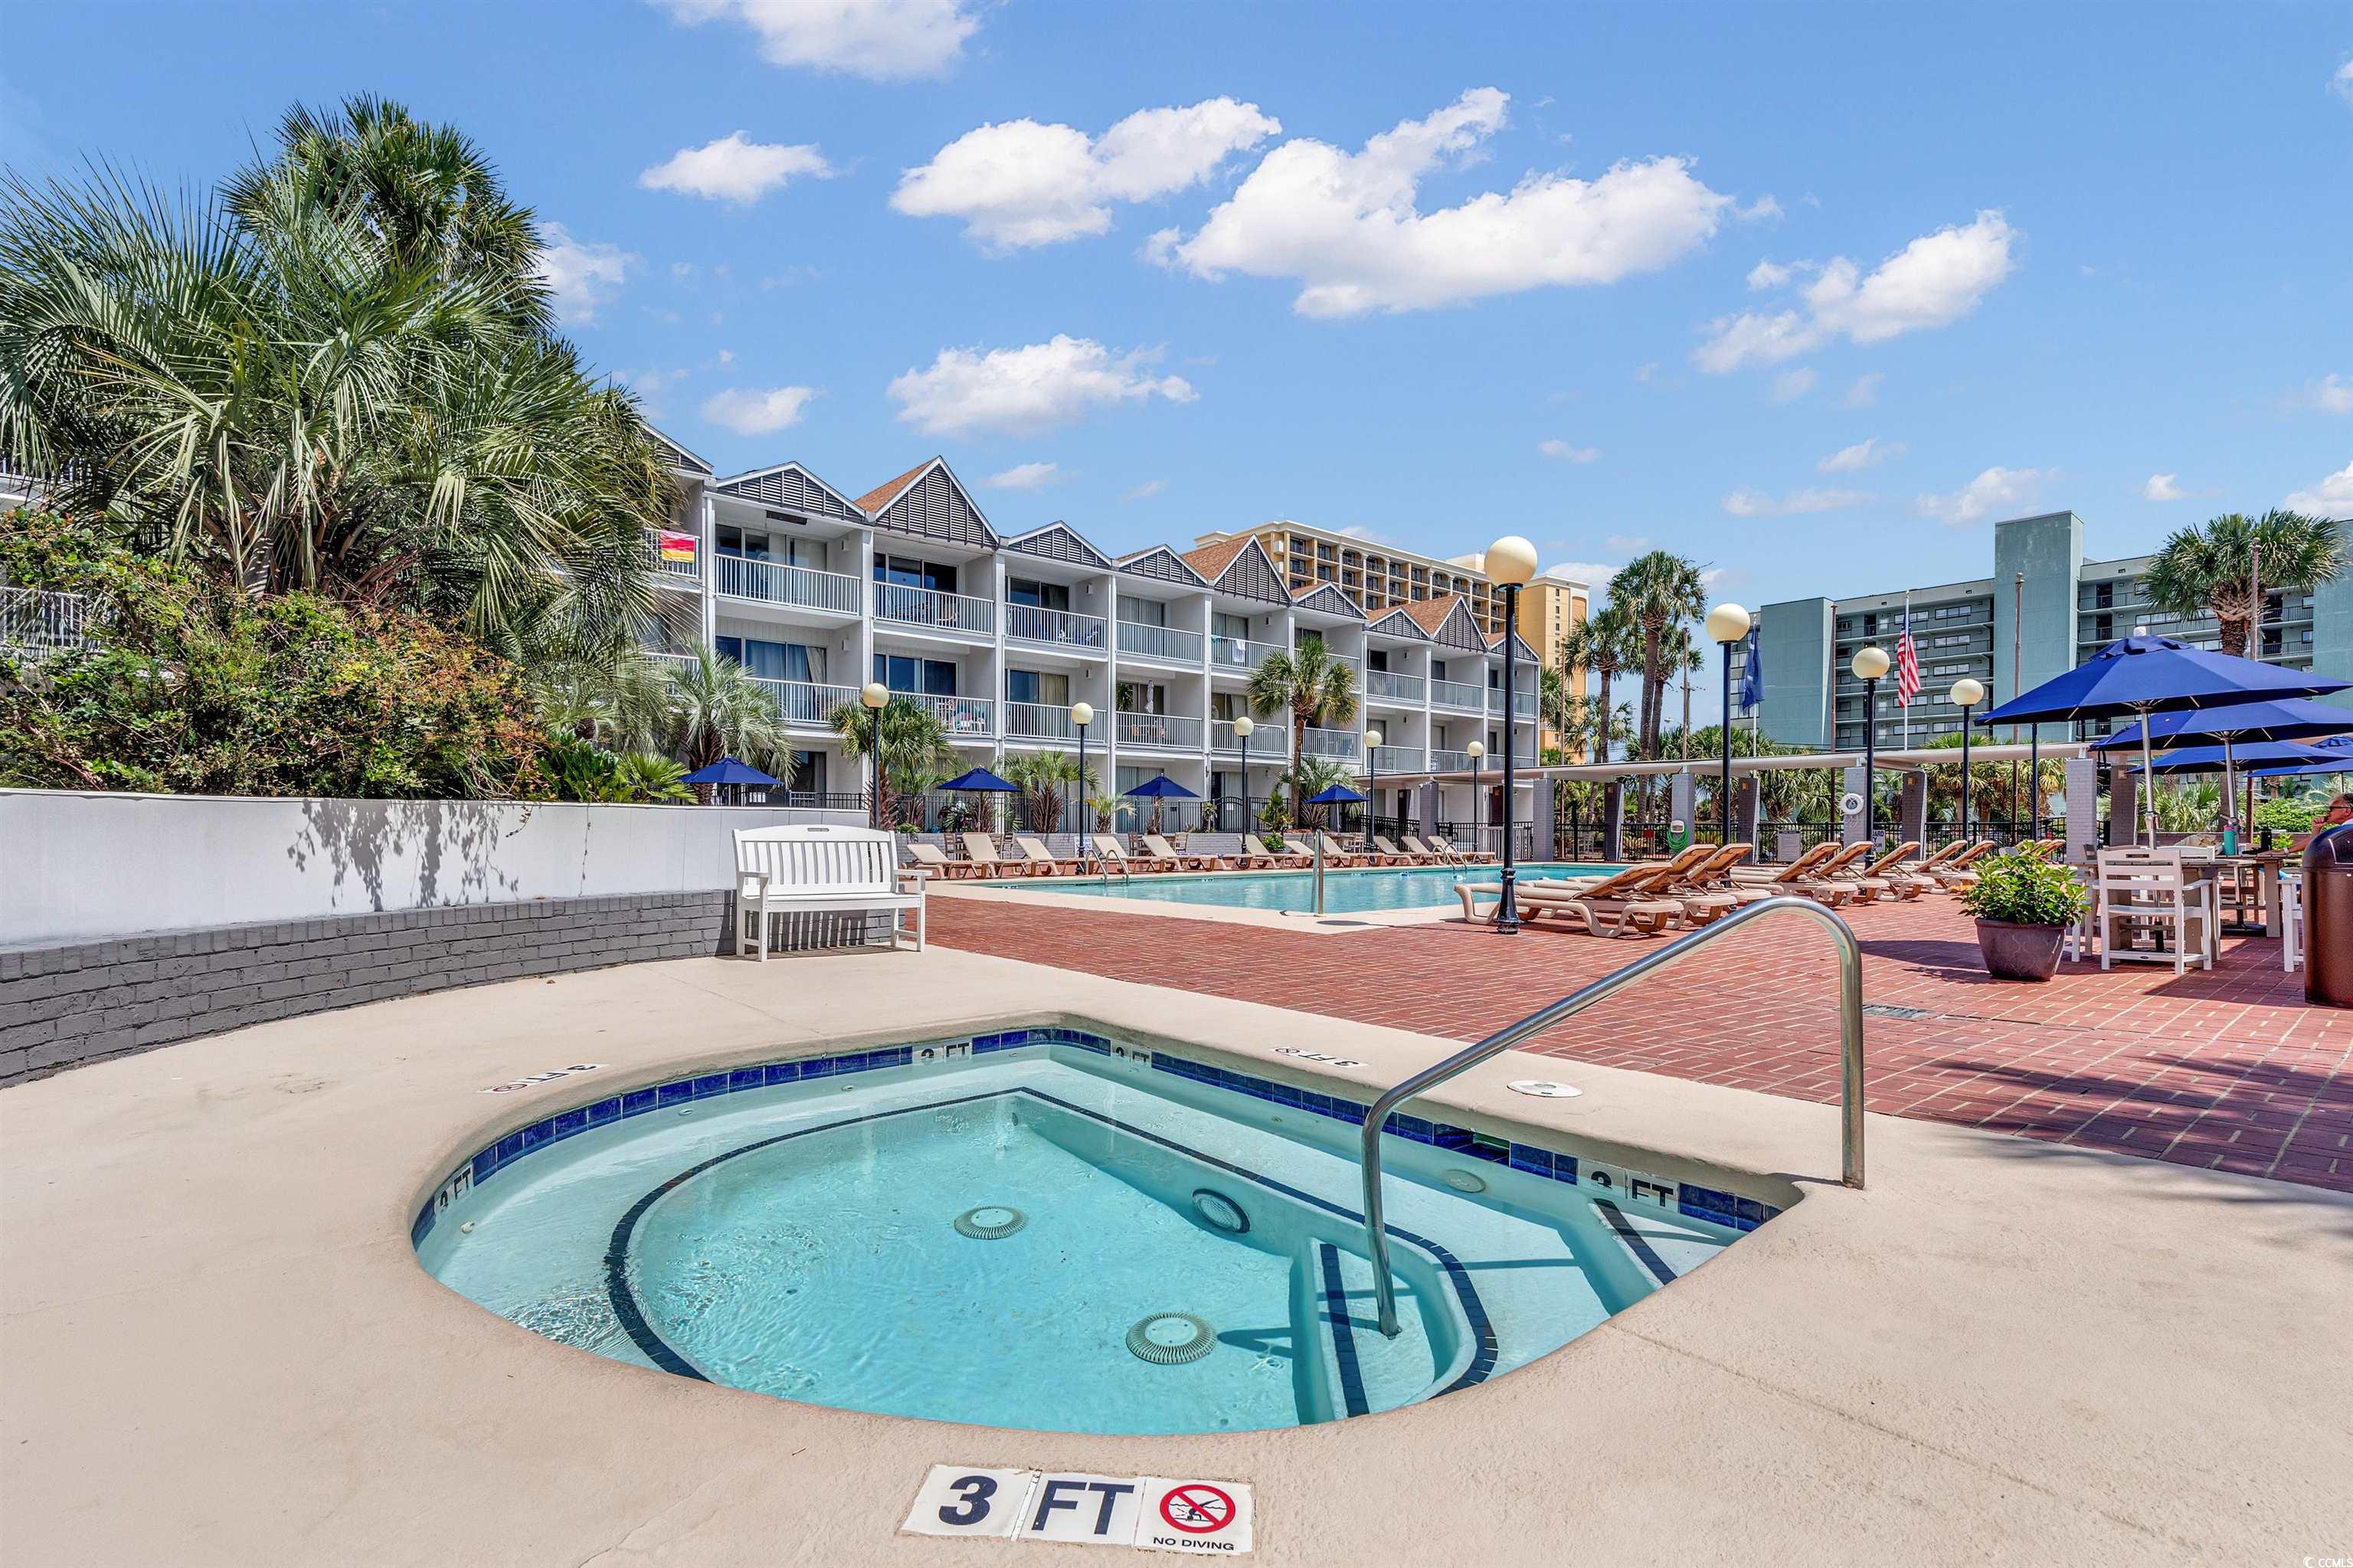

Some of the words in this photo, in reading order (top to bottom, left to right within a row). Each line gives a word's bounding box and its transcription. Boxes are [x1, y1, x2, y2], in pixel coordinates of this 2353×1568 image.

[1631, 1178, 1674, 1207] FT
[938, 1475, 998, 1526] 3
[1031, 1479, 1134, 1535] FT
[1153, 1537, 1176, 1546] NO
[1181, 1539, 1235, 1551] DIVING
